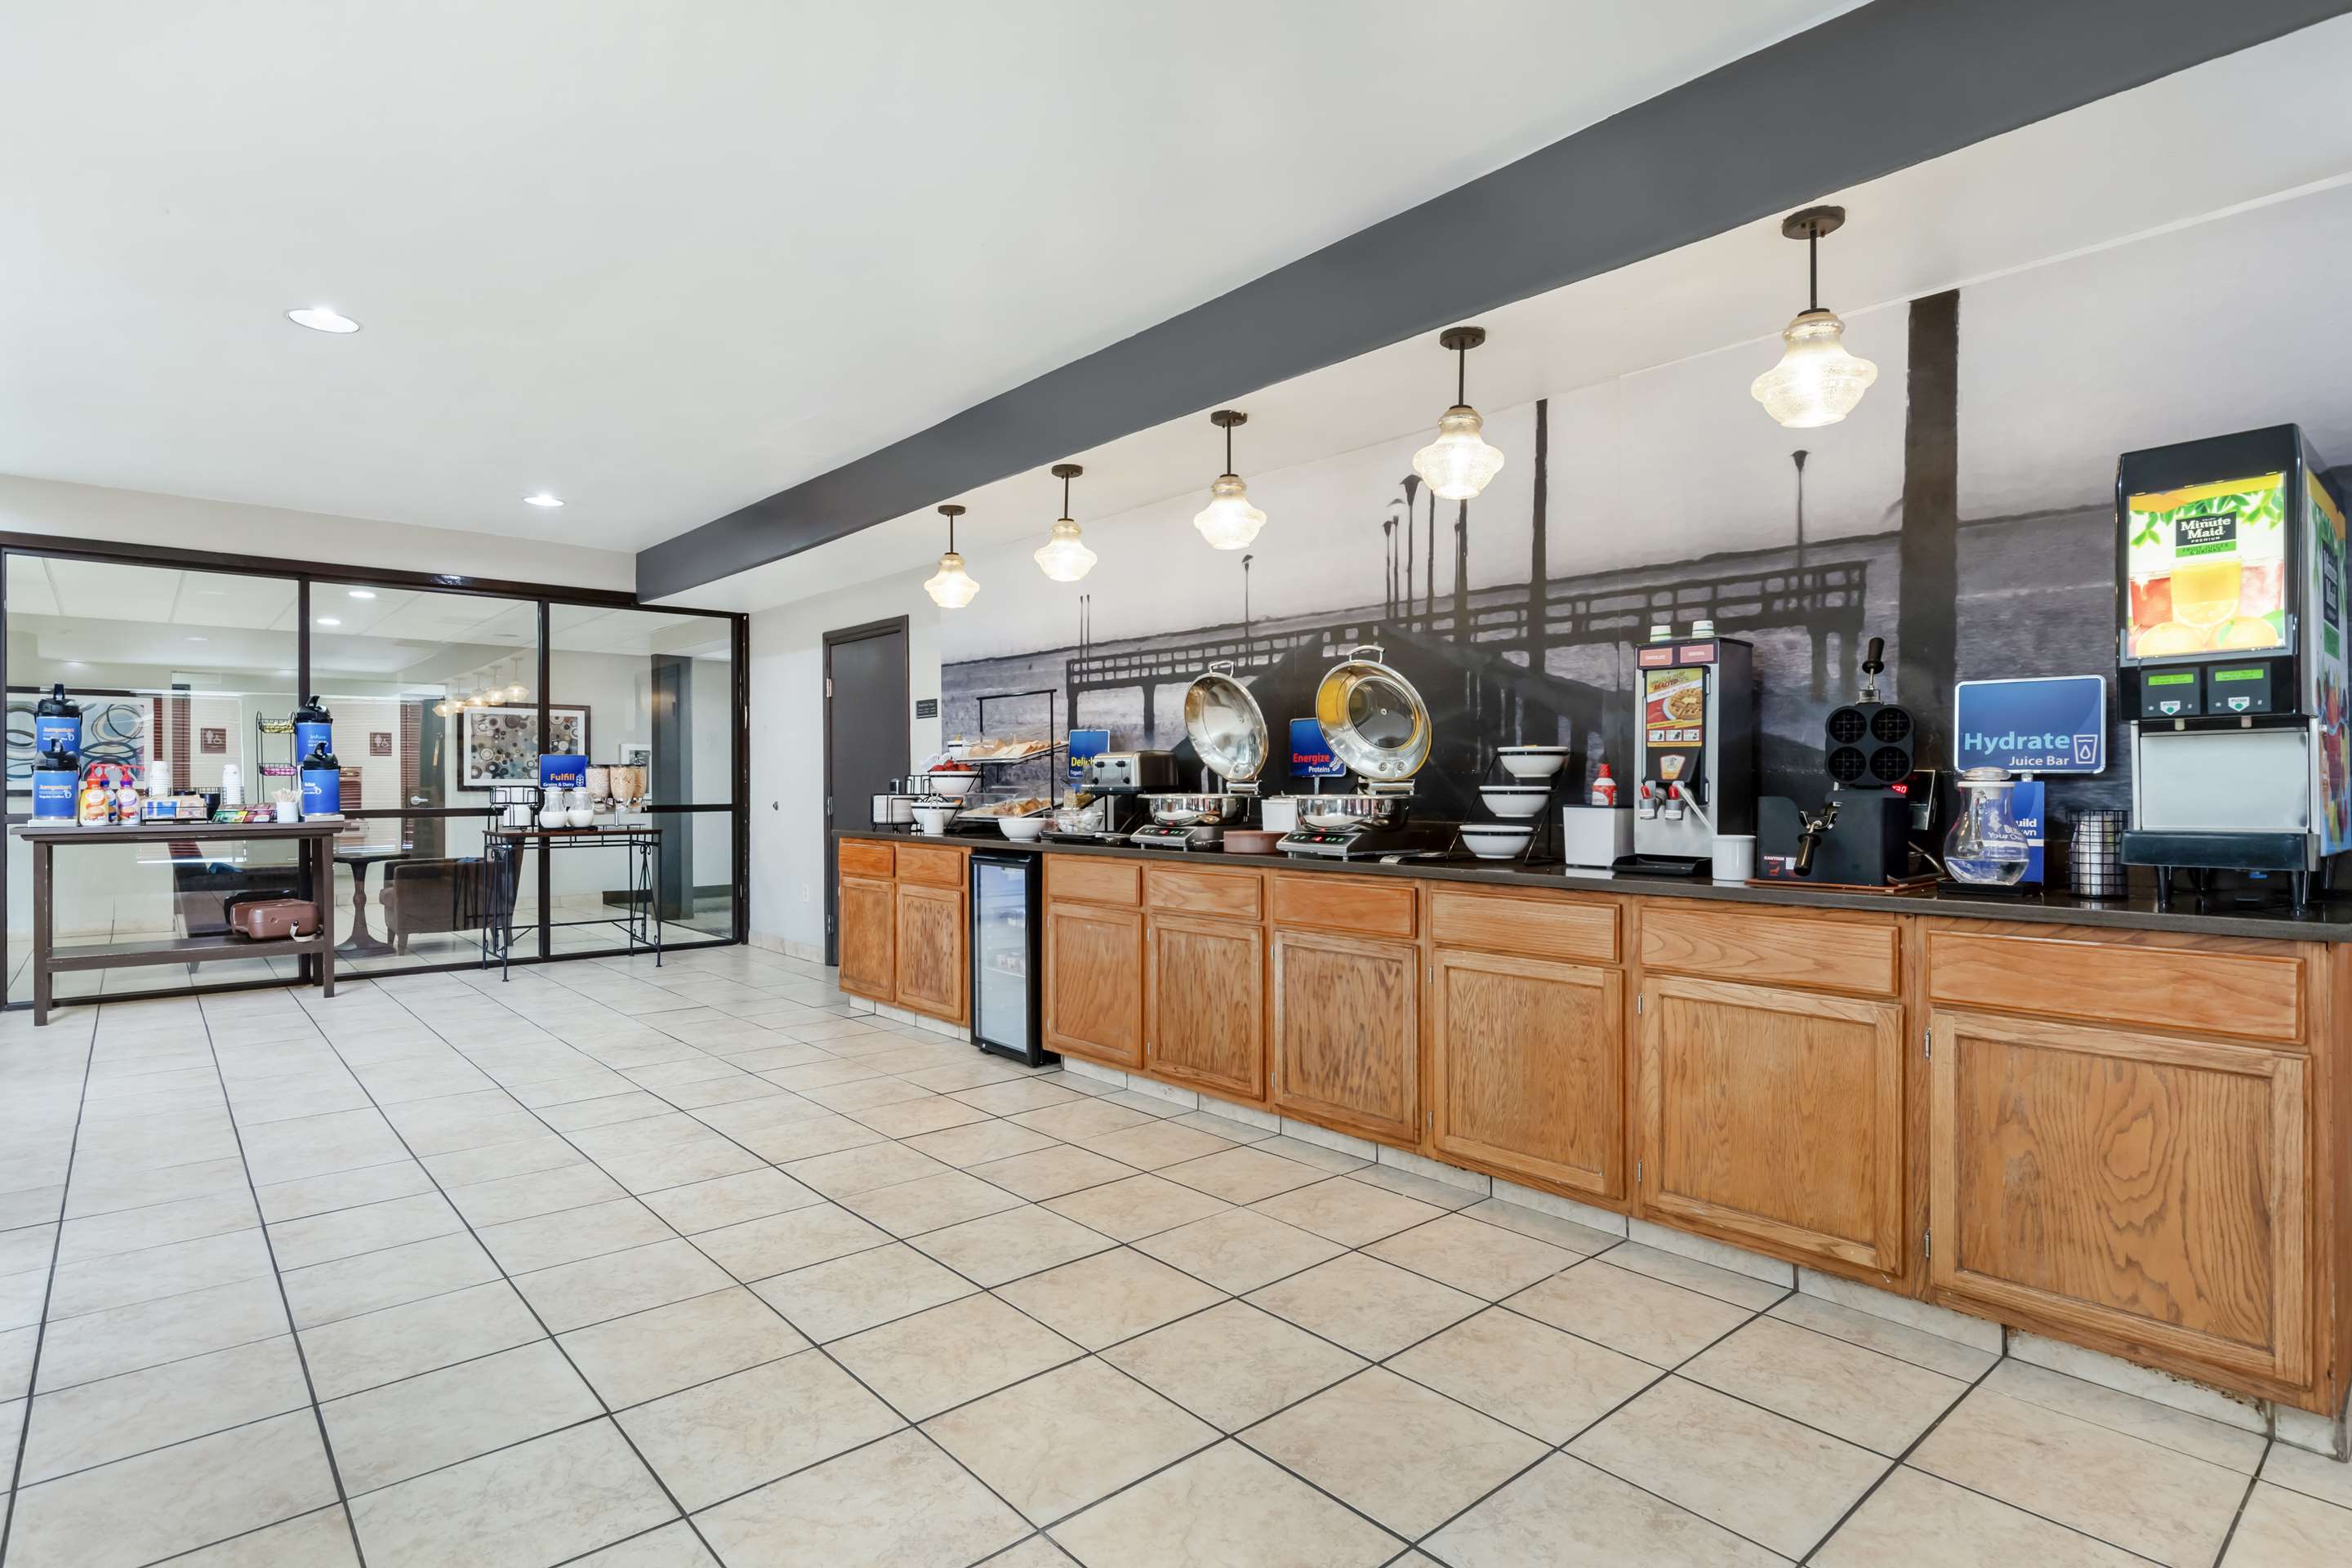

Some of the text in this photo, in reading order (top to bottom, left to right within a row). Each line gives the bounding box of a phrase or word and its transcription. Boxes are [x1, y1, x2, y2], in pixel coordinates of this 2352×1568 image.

[2180, 517, 2231, 531] Minute
[2187, 526, 2224, 539] Maid
[1964, 732, 2070, 755] Hydrate
[1293, 753, 1330, 765] Energize
[2009, 755, 2069, 765] Juice Bar
[1988, 831, 2008, 840] Your
